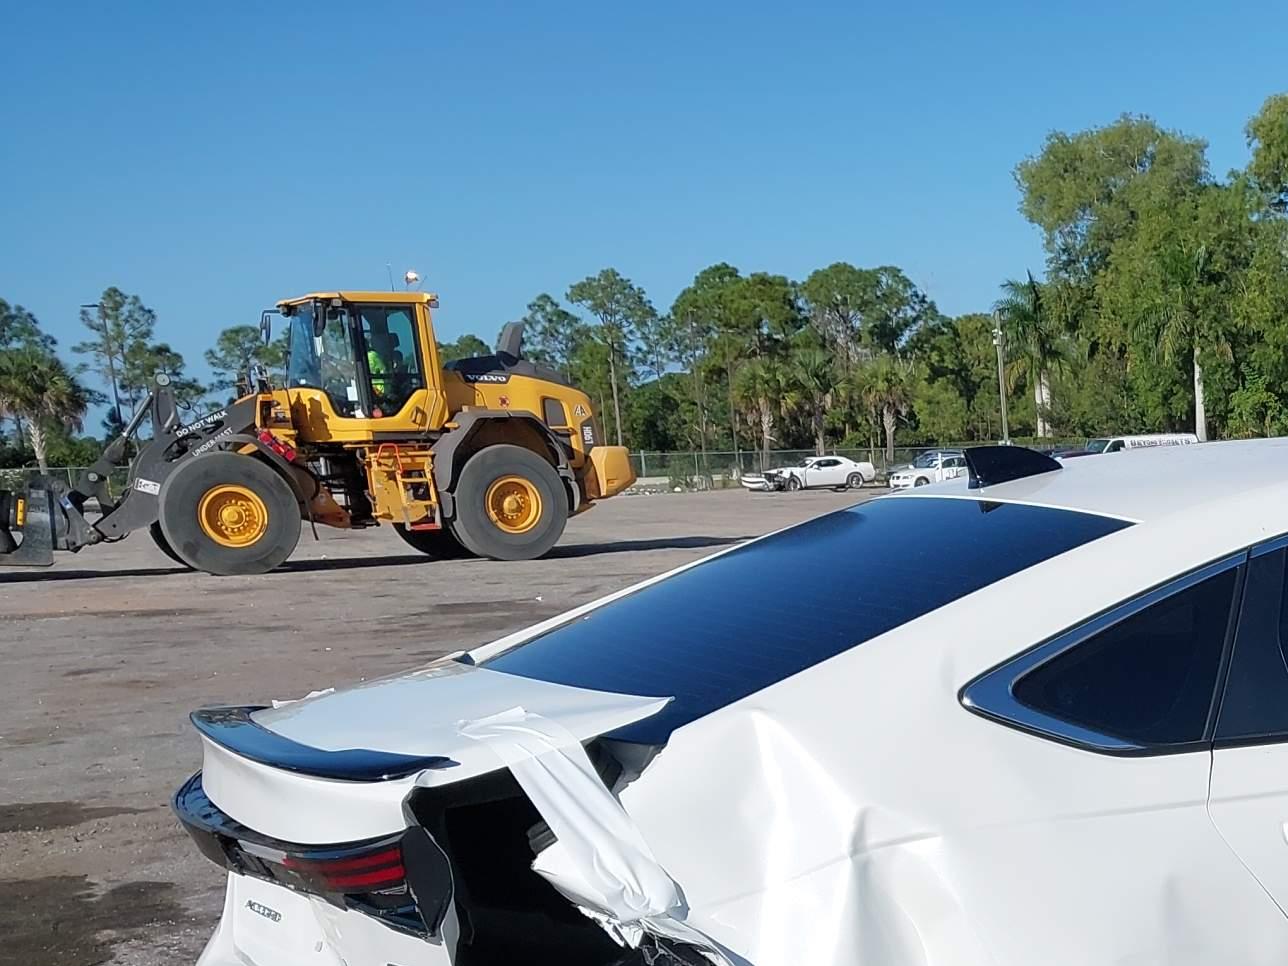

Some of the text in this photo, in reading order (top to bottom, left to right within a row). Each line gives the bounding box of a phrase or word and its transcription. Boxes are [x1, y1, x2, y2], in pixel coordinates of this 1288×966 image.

[467, 374, 507, 382] VOLVO
[176, 410, 228, 438] DO NOT WALK
[582, 426, 594, 445] L90H
[192, 439, 217, 457] UNDER
